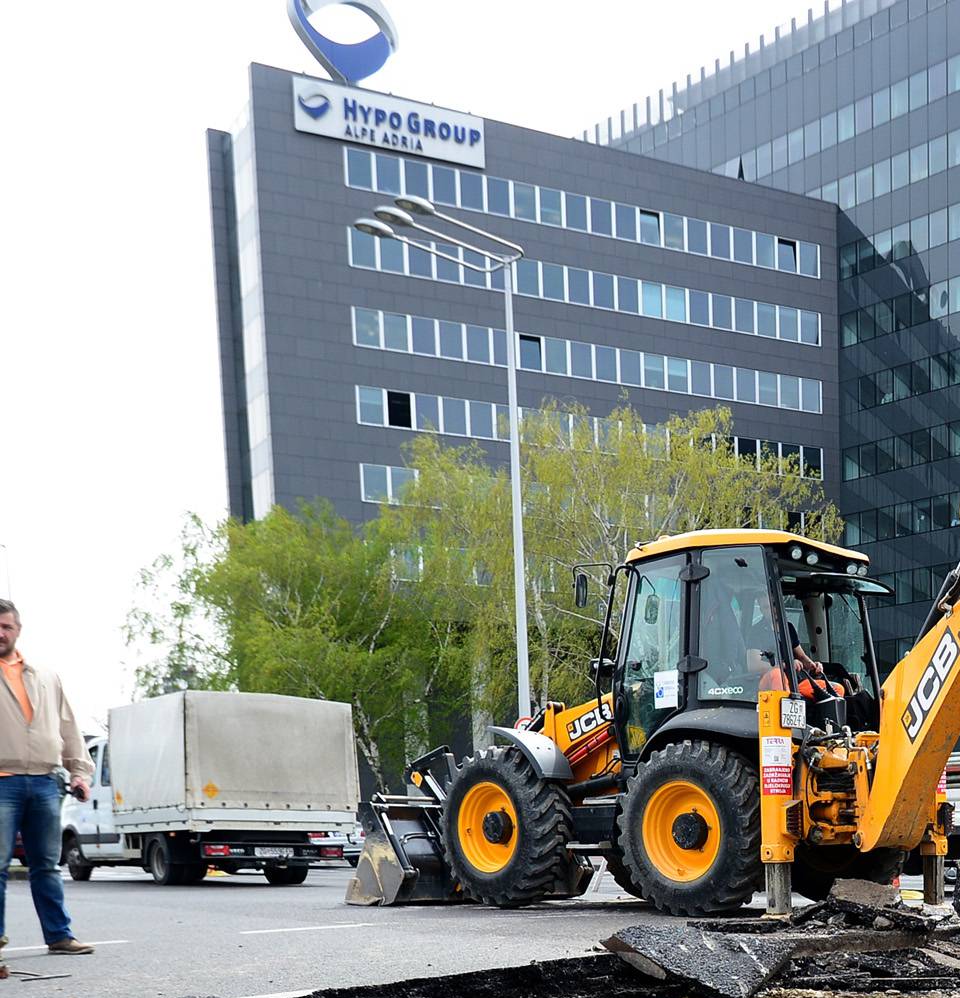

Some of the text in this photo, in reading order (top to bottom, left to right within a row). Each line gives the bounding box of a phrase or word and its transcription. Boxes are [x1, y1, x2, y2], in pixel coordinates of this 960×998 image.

[345, 125, 424, 152] ALPE ADRIA
[907, 633, 958, 738] JCB
[789, 701, 799, 714] ZG
